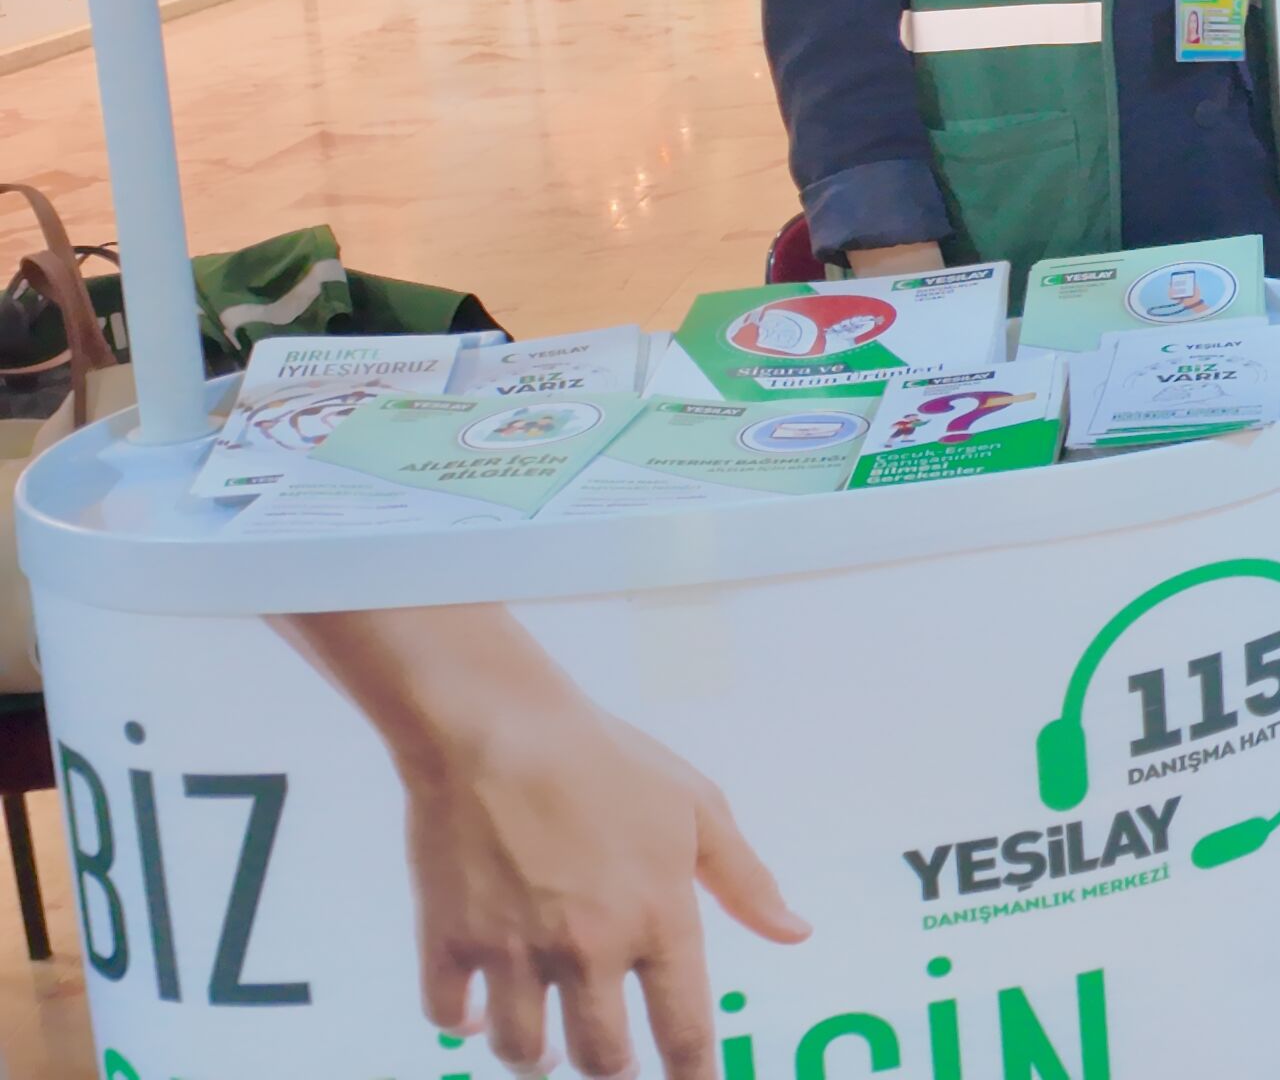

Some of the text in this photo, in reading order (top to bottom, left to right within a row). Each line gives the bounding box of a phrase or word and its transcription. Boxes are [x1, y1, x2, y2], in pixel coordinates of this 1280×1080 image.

[1127, 739, 1236, 786] DANIŞMA
[58, 720, 312, 1007] BİZ
[922, 862, 1171, 931] DANIŞMANLIK MERKEZİ
